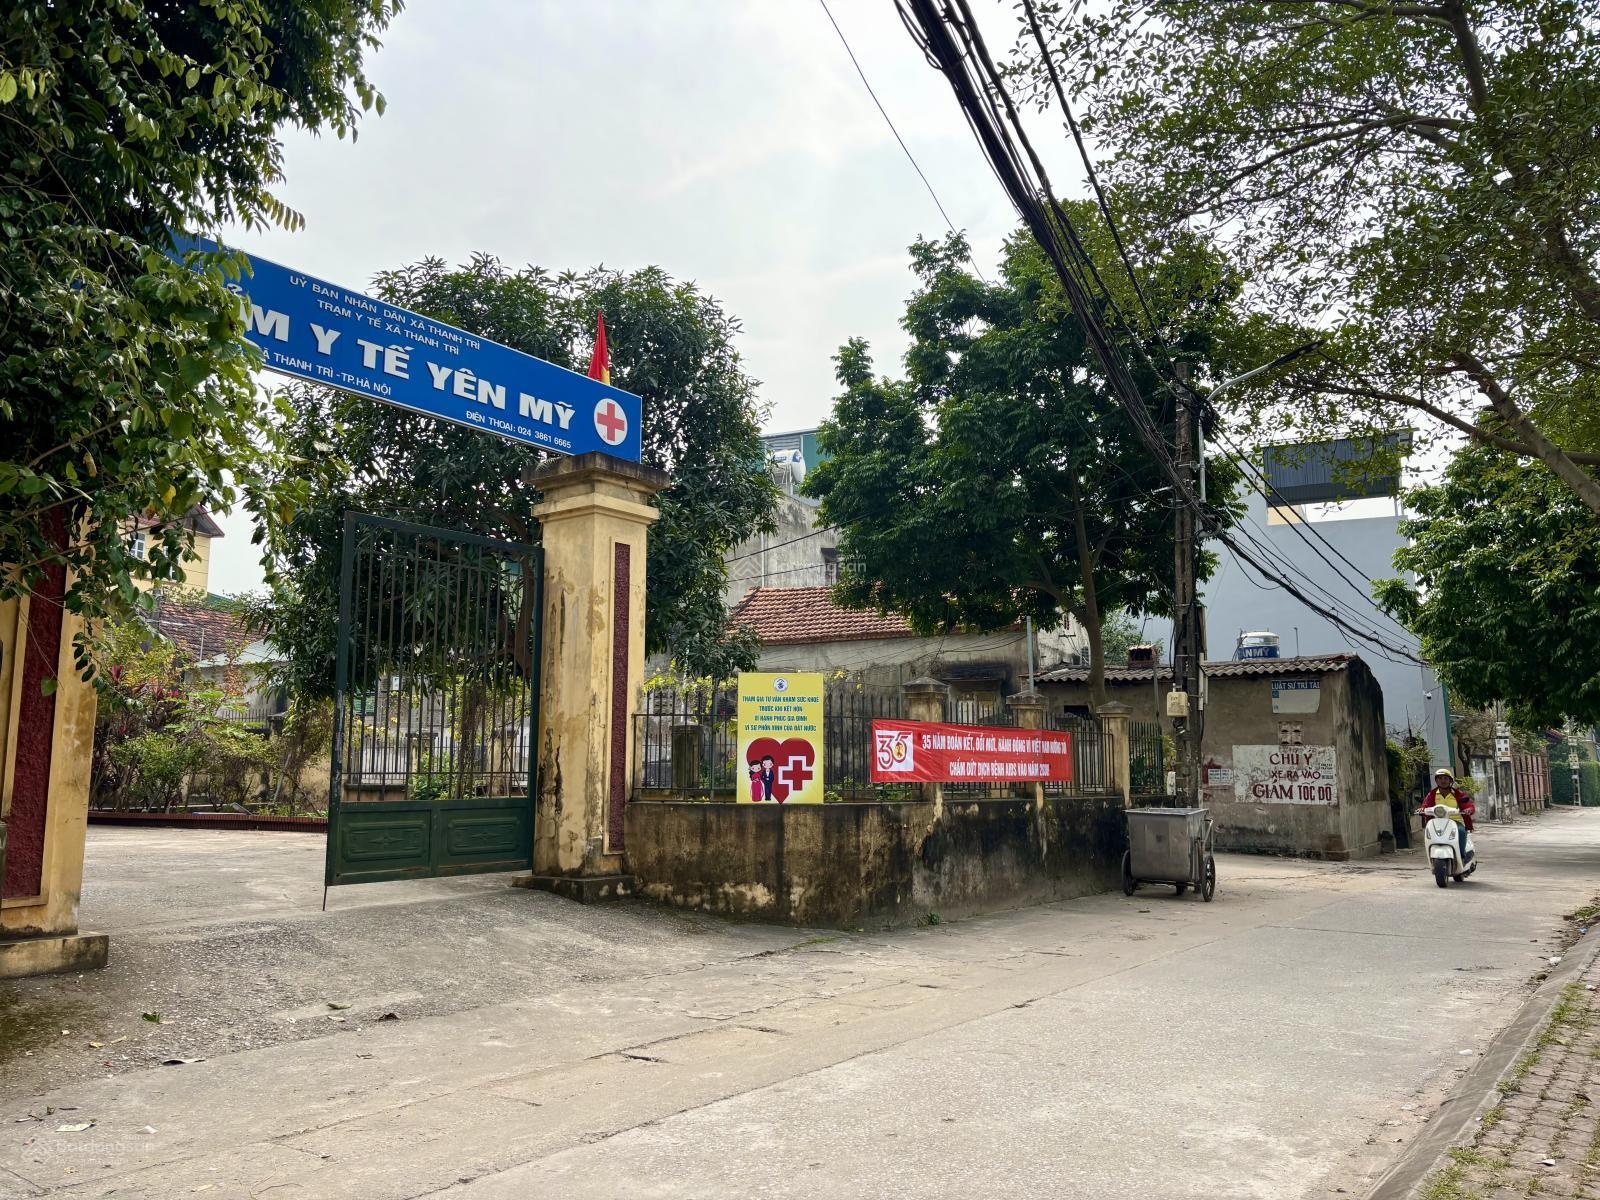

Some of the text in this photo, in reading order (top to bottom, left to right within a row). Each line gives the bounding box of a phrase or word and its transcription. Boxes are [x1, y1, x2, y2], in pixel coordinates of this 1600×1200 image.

[312, 284, 339, 300] BAN
[344, 295, 377, 314] NHÂN
[383, 308, 406, 324] DÂN
[410, 318, 425, 331] XÃ
[429, 325, 462, 345] THANH
[464, 337, 480, 350] TRÌ
[317, 299, 459, 355] TRẠM Y TẾ XÃ THANH TRÌ
[273, 353, 312, 370] THANH
[316, 364, 334, 378] TRÌ
[373, 382, 391, 396] NỘI
[310, 322, 576, 430] Y TẾ YÊN MỸ
[466, 410, 572, 449] ĐIỆN THOẠI: 024 3861 6665
[922, 735, 931, 749] 35
[932, 732, 946, 749] NĂM
[947, 733, 962, 750] ĐOÀN
[1304, 749, 1313, 765] Ý
[949, 757, 966, 776] CHẤM
[991, 760, 1005, 779] BỆNH
[1271, 770, 1286, 779] XE
[1286, 770, 1299, 779] RA
